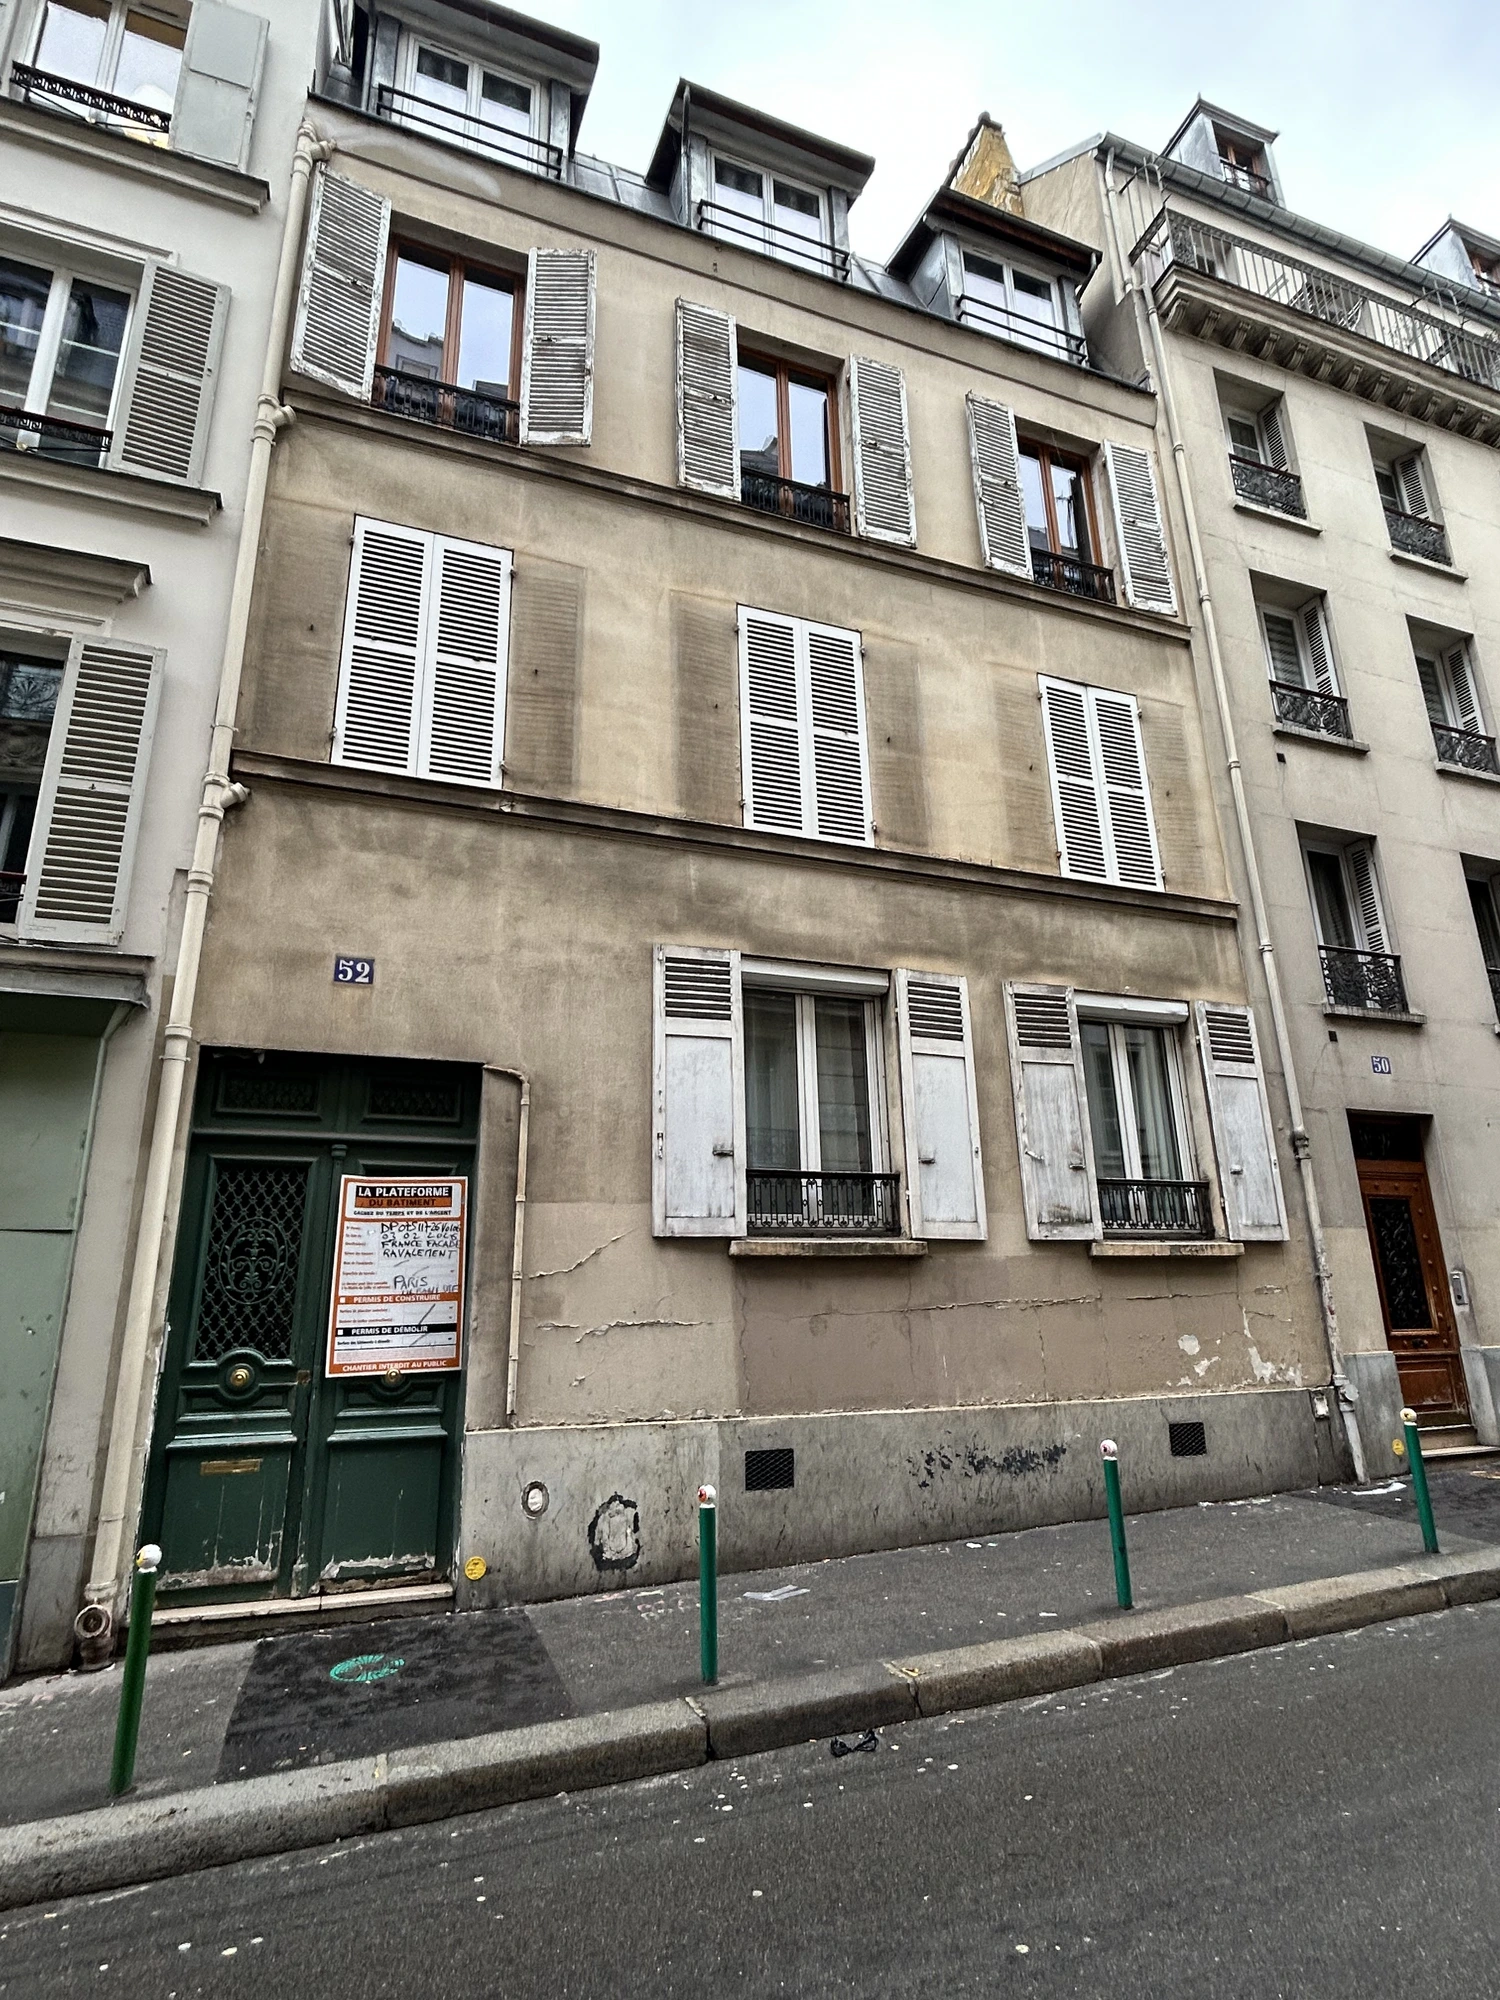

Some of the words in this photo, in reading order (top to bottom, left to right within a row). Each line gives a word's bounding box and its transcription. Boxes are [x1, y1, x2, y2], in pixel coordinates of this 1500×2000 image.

[338, 959, 370, 983] 52
[1372, 1056, 1389, 1073] 50
[358, 1187, 371, 1197] LA
[375, 1187, 449, 1197] PLATEFORME
[381, 1239, 422, 1249] FRANCE
[383, 1248, 457, 1259] RAVALEMENT
[353, 1295, 381, 1303] PERMIS
[384, 1294, 394, 1302] DE
[395, 1293, 440, 1302] CONSTRUIRE
[351, 1327, 380, 1335] PERMIS
[381, 1326, 392, 1334] DE
[342, 1364, 377, 1372] CHANTIER
[378, 1362, 410, 1370] INTERDIT
[423, 1359, 447, 1367] PUBLIC
